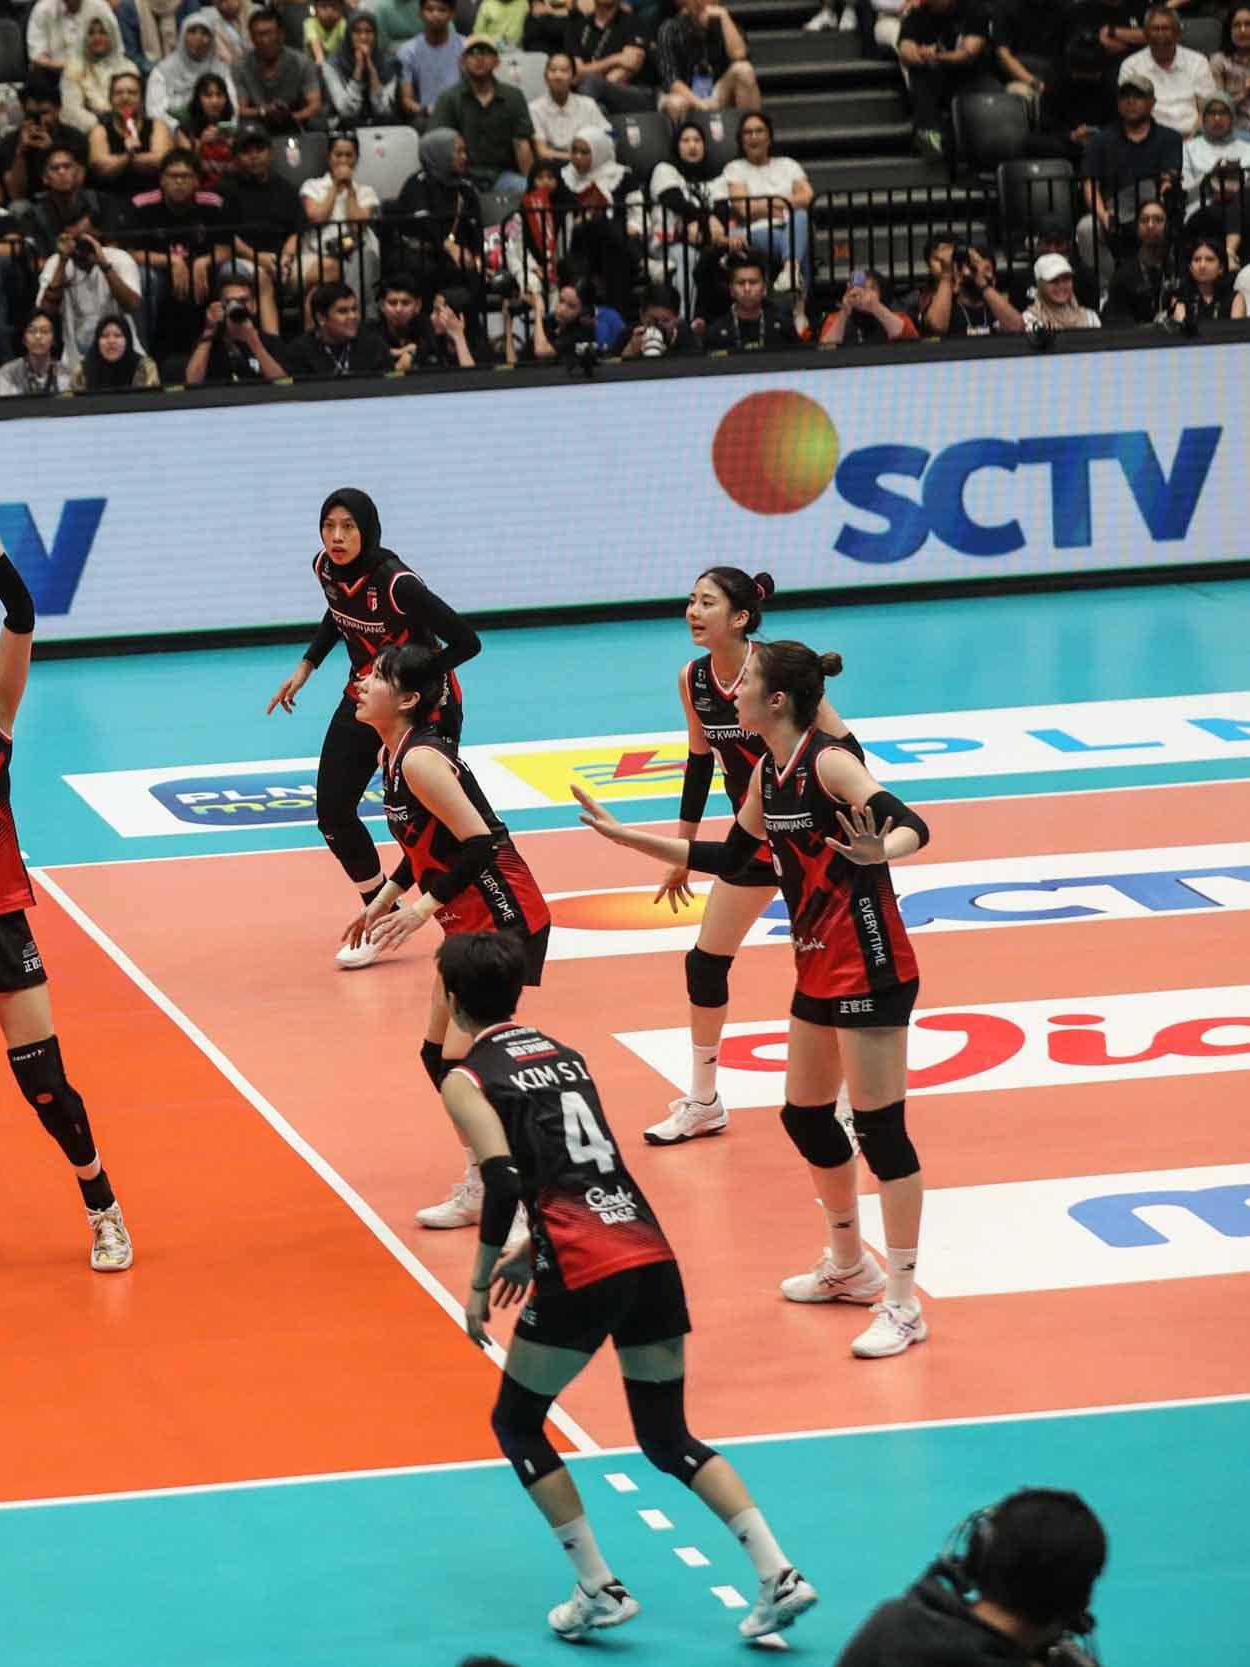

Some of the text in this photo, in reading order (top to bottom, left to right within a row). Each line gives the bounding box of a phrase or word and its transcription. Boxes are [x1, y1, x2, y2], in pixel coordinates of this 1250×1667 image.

[833, 425, 1223, 564] SCTV
[175, 785, 318, 804] PLN
[479, 868, 515, 922] VERYTIME
[859, 896, 887, 967] EVERYTIME
[509, 1065, 561, 1092] KIM
[556, 1061, 578, 1082] S
[560, 1090, 616, 1174] 4
